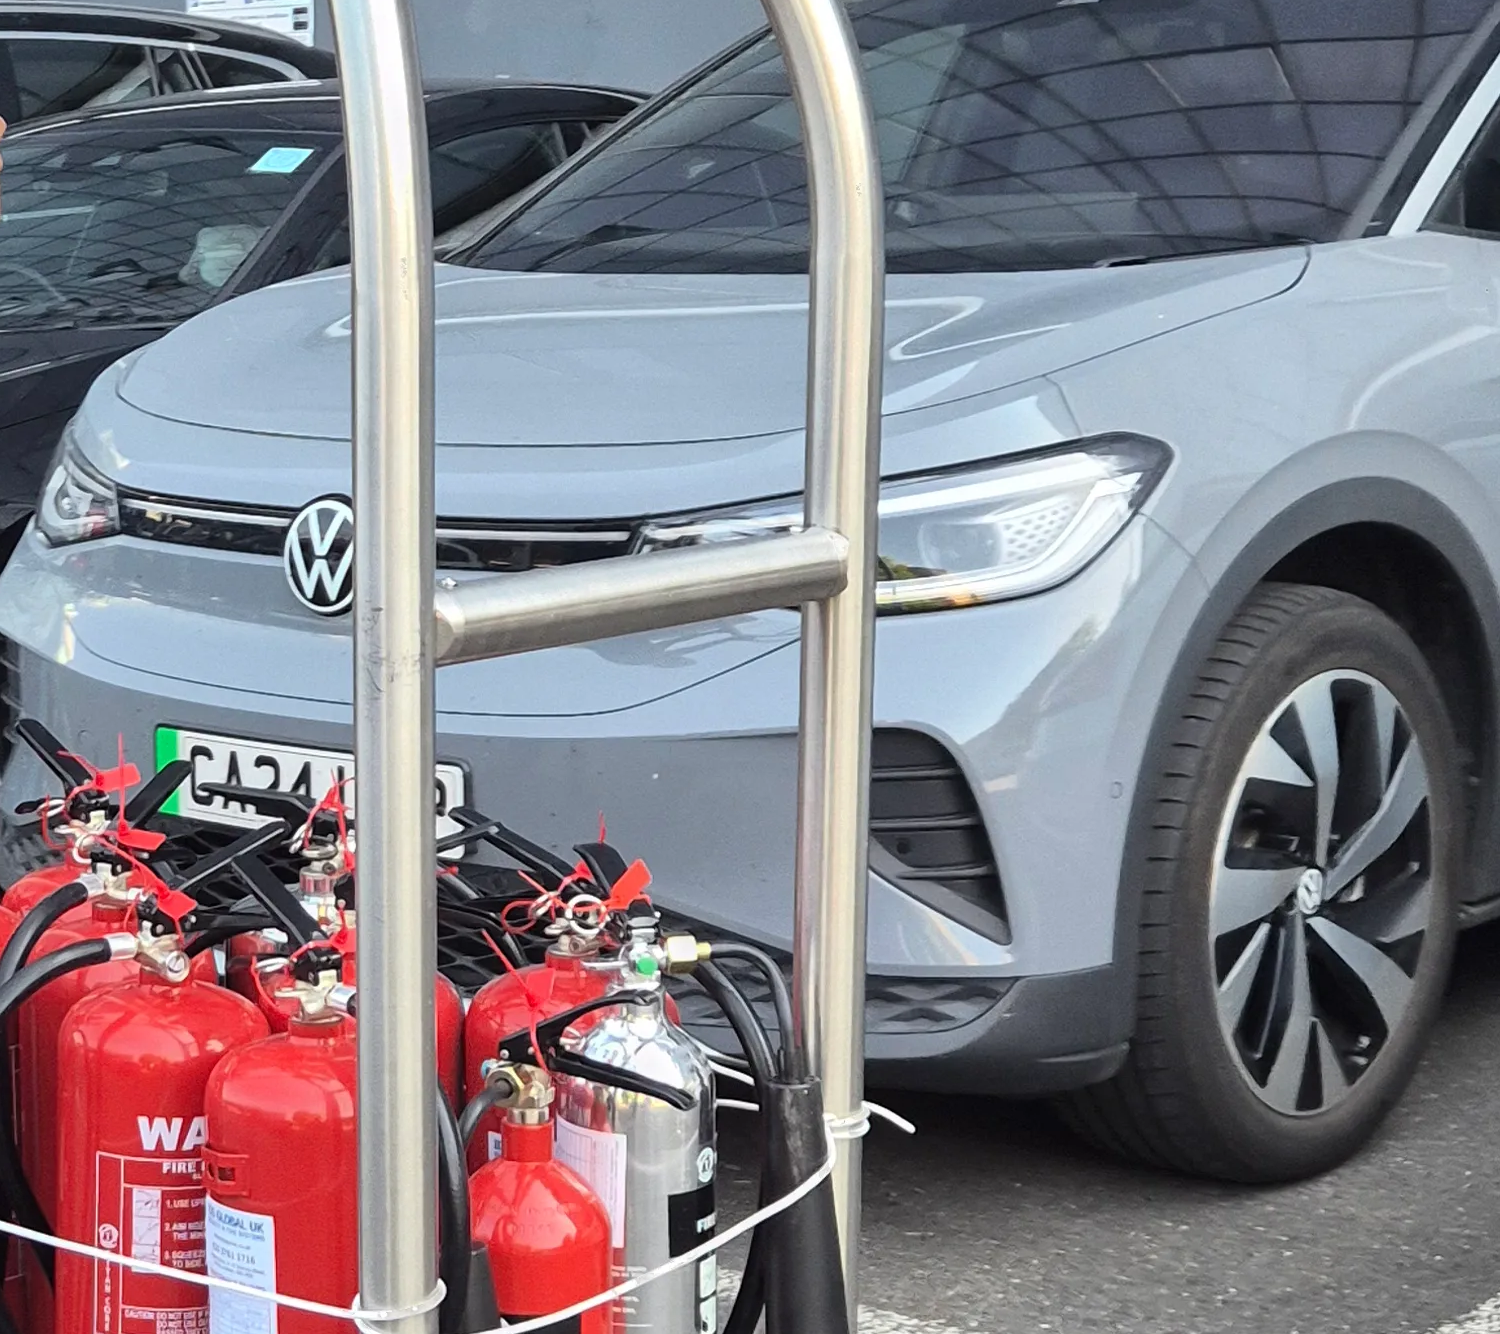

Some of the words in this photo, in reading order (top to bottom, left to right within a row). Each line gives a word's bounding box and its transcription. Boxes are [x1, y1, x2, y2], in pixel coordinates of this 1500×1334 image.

[136, 1115, 209, 1151] WA
[162, 1161, 197, 1174] FIRE
[216, 1209, 247, 1231] GLOBAL
[249, 1220, 265, 1233] UK
